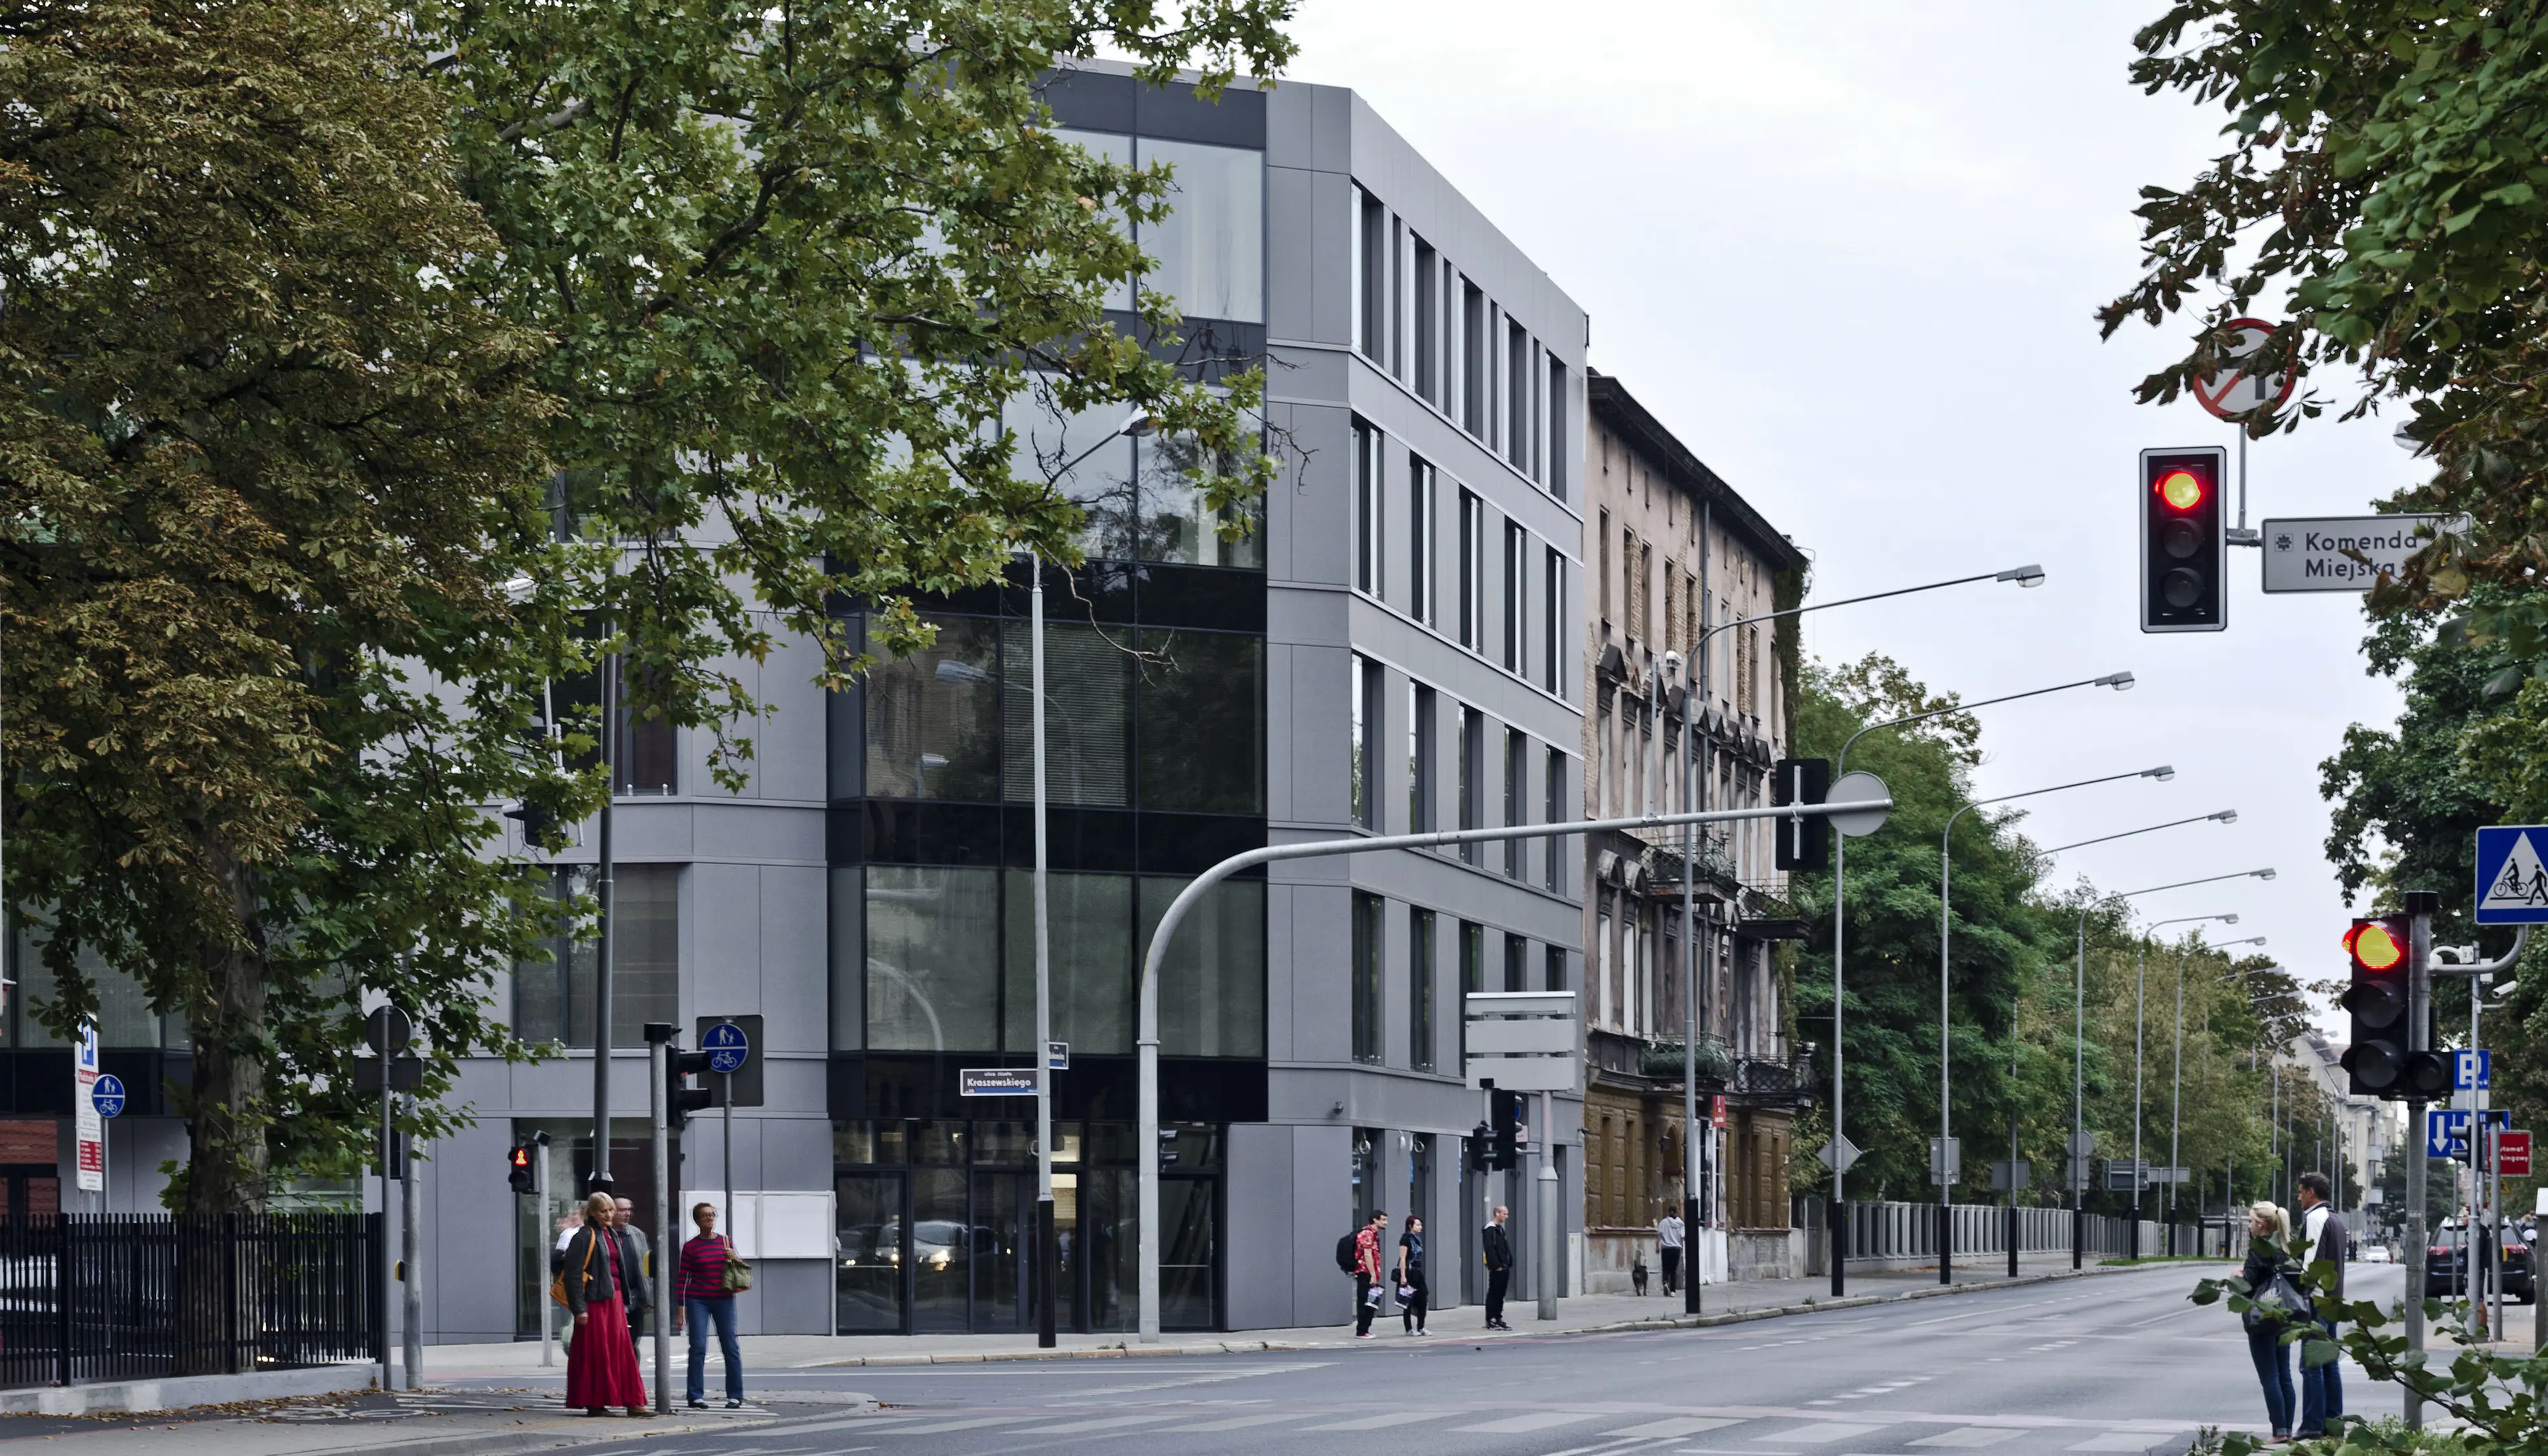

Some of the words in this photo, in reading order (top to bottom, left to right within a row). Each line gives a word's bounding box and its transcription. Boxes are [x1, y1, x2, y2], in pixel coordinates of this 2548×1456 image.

[2305, 530, 2418, 552] Komenda
[2305, 558, 2395, 581] Miejska
[83, 1024, 92, 1061] P
[2459, 1053, 2482, 1086] P
[967, 1078, 1031, 1088] Kraszewskiego
